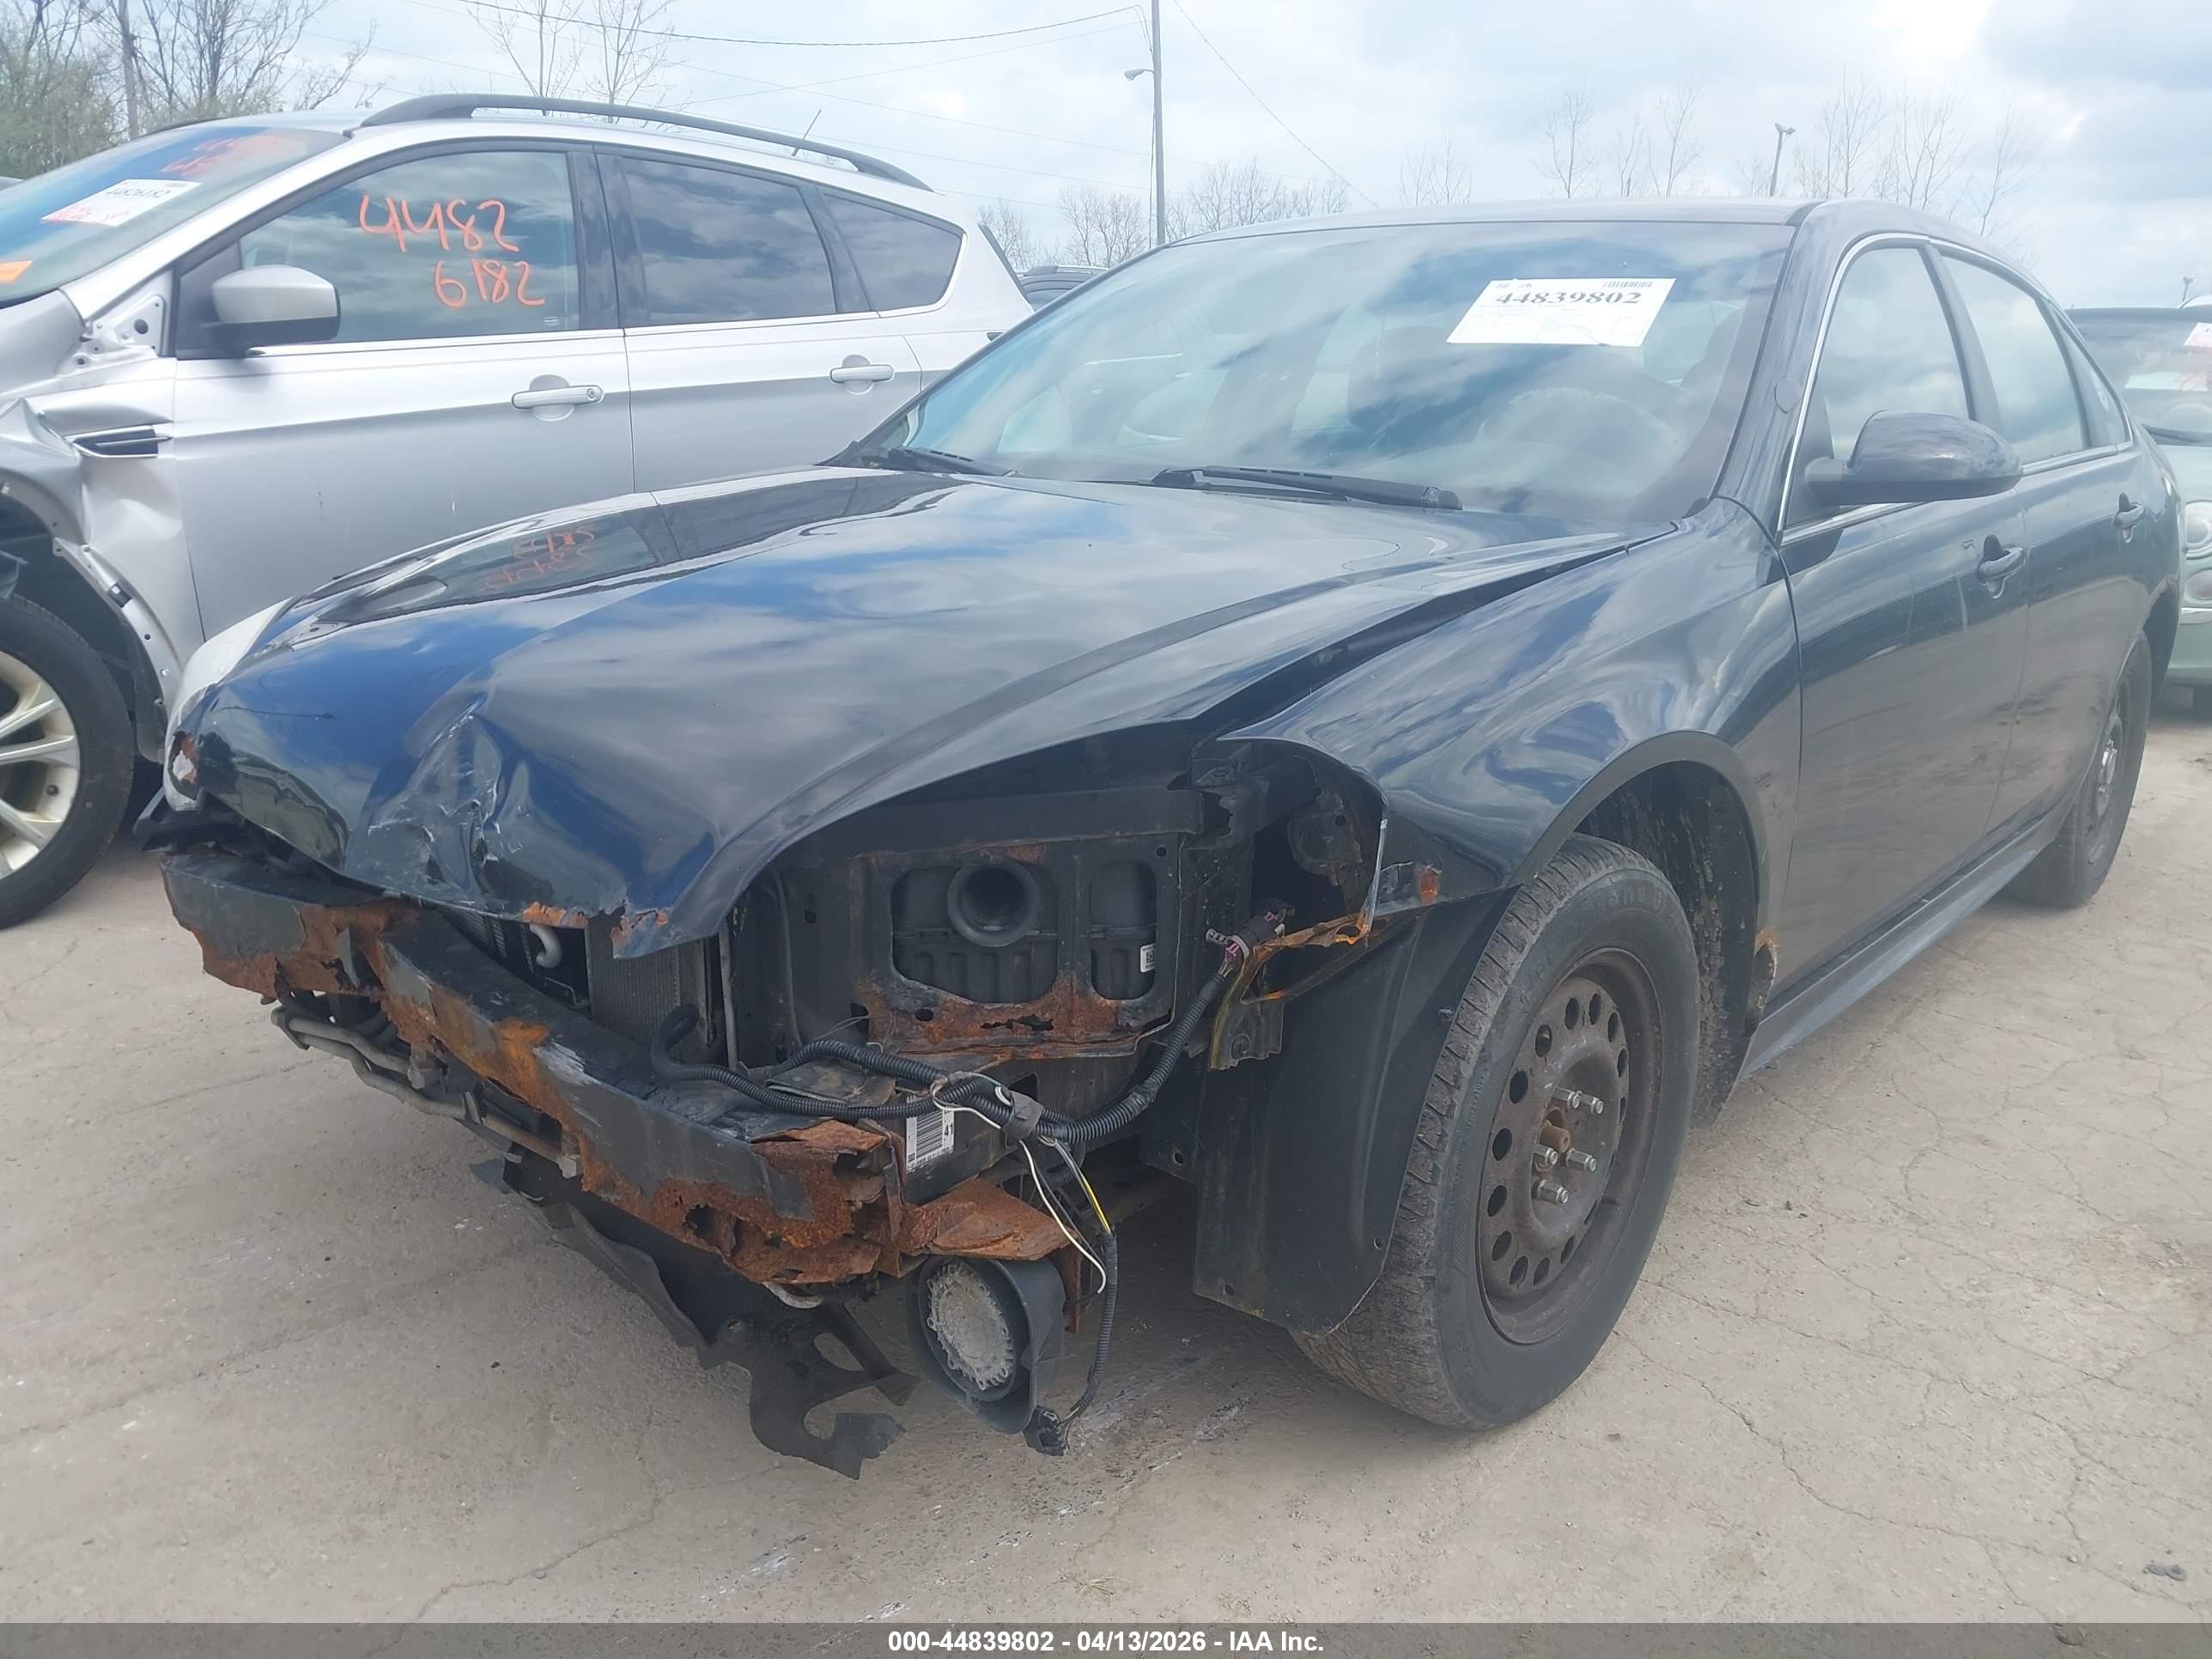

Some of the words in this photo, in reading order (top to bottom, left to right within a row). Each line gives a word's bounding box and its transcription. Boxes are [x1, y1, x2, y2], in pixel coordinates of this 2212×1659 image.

[358, 194, 520, 253] 4482
[434, 259, 545, 308] 6182
[1495, 291, 1643, 304] 44839802
